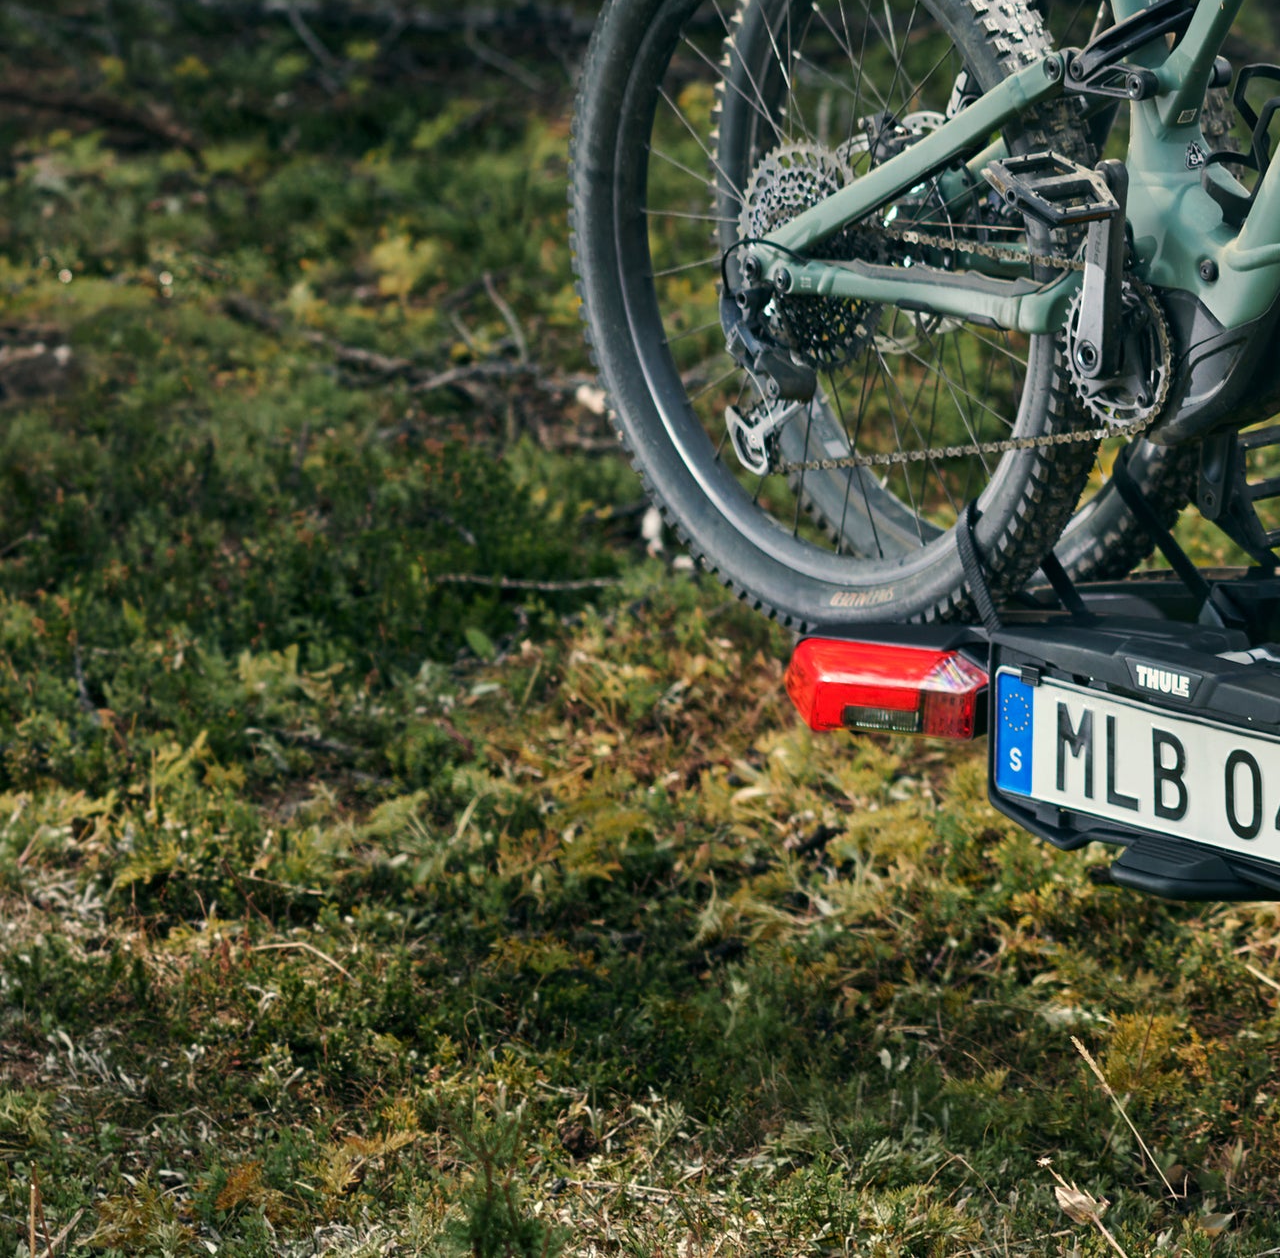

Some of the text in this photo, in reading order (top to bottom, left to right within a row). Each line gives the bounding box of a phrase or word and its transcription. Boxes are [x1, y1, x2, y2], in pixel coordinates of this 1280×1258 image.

[1136, 664, 1190, 698] THULE
[1009, 747, 1023, 772] S
[1056, 701, 1188, 822] MLB
